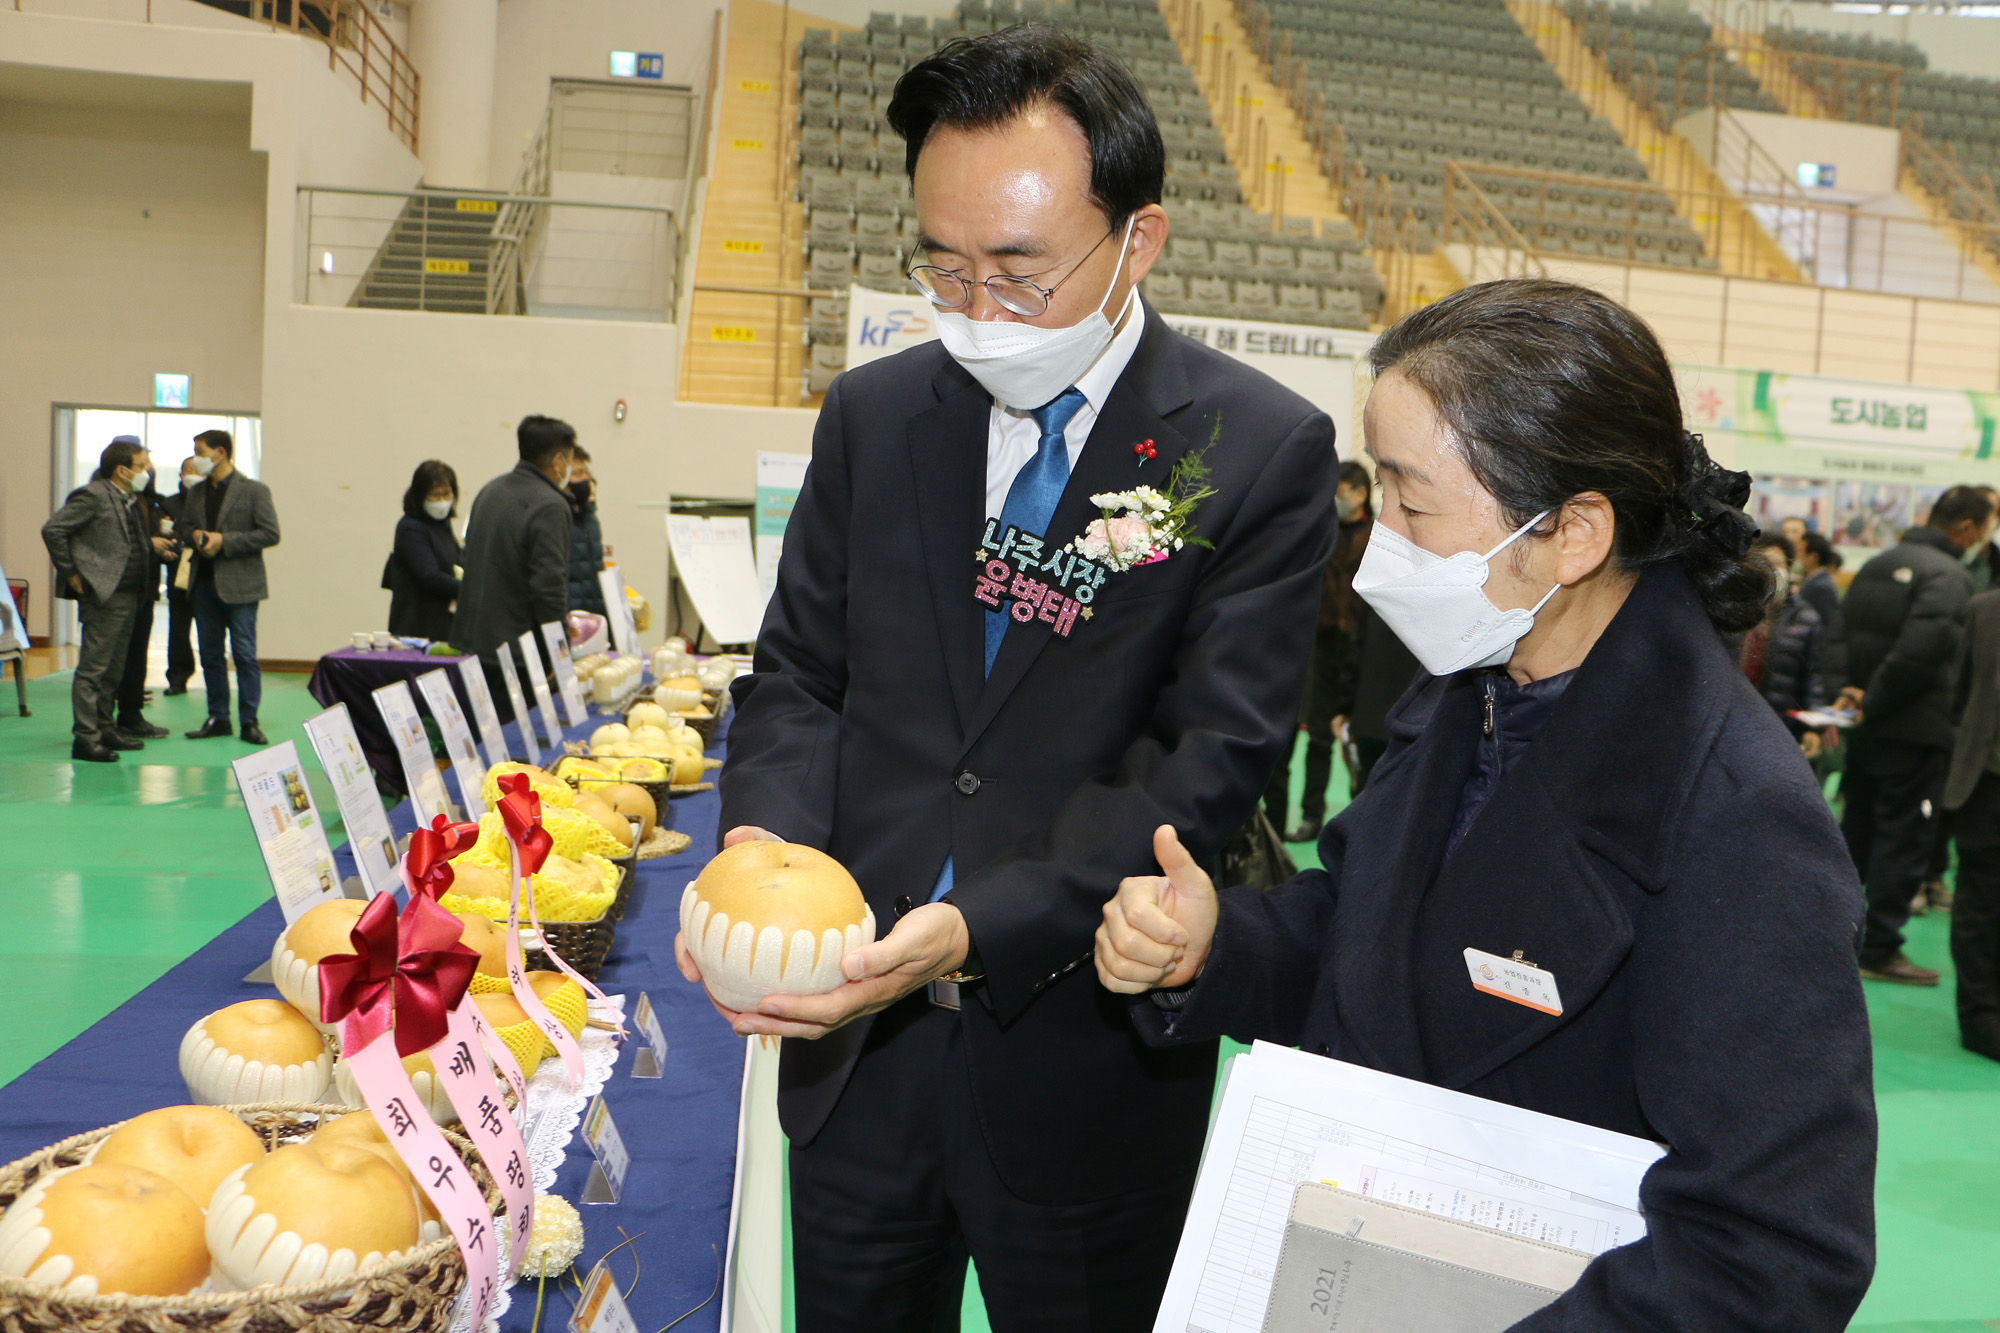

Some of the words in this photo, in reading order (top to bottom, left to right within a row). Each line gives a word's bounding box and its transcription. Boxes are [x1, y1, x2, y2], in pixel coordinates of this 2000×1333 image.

[1831, 398, 1927, 430] 도시농업
[981, 520, 1106, 604] 나주시장
[974, 559, 1081, 637] 윤병태
[1310, 1268, 1337, 1316] 2021
